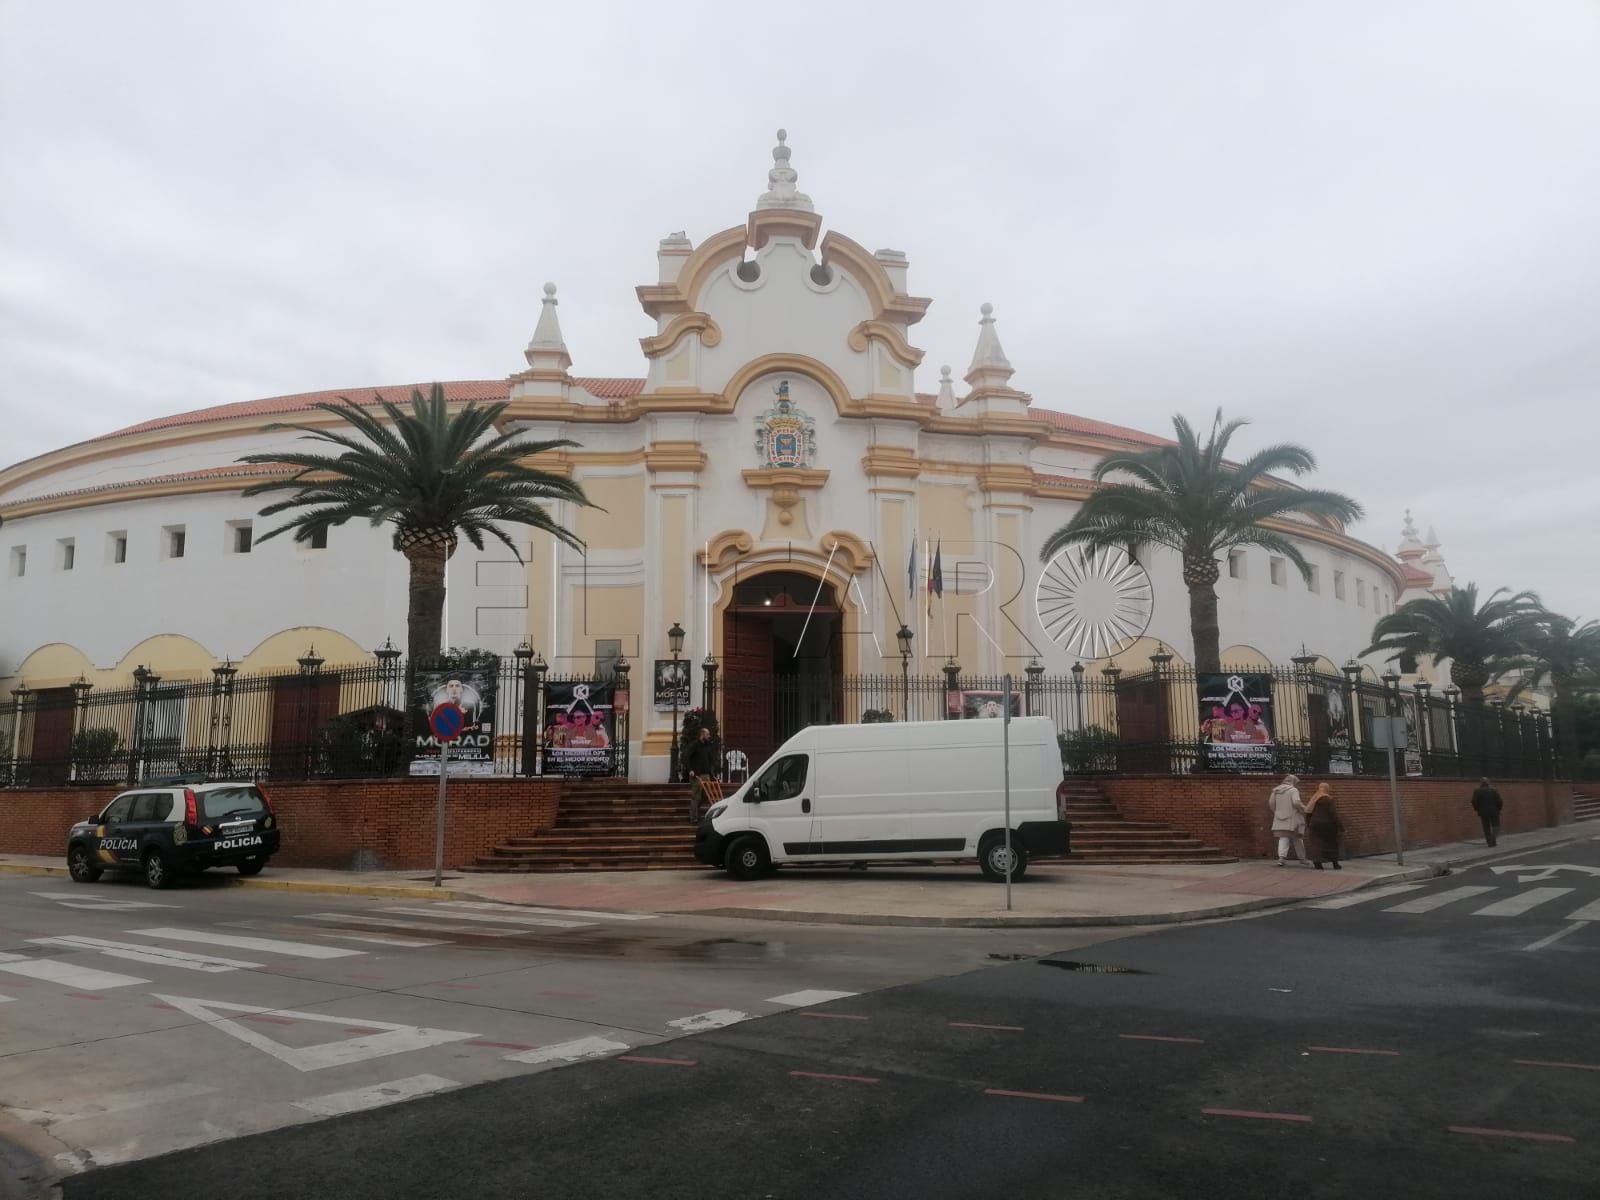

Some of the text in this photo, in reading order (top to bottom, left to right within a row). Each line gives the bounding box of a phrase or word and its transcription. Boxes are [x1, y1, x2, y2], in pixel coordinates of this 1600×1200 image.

[416, 735, 490, 747] MRAD
[99, 839, 138, 850] POLICIA
[214, 836, 263, 850] POLICIA
